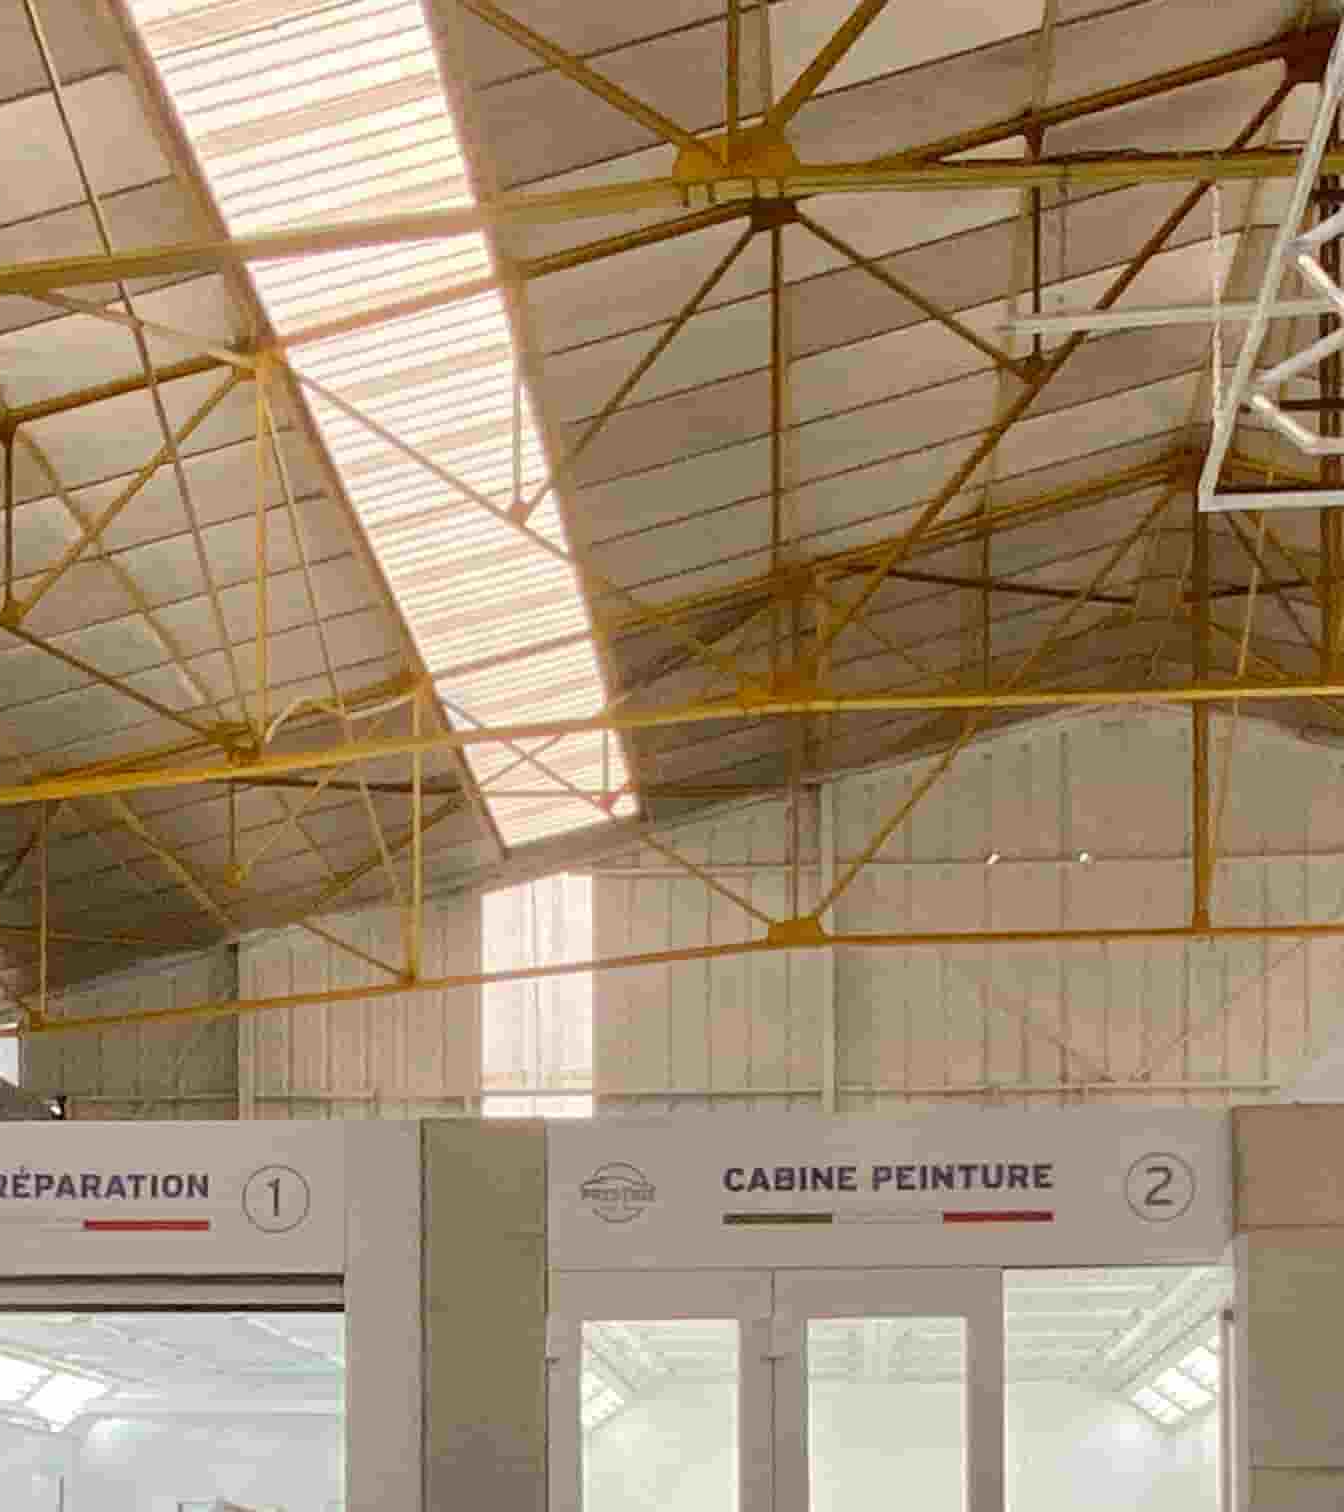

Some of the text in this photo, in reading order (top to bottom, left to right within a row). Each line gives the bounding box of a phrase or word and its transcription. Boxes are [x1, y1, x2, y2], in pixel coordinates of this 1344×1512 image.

[266, 1176, 282, 1217] 1
[722, 1163, 1055, 1193] CABINE PEINTURE
[1145, 1166, 1175, 1206] 2
